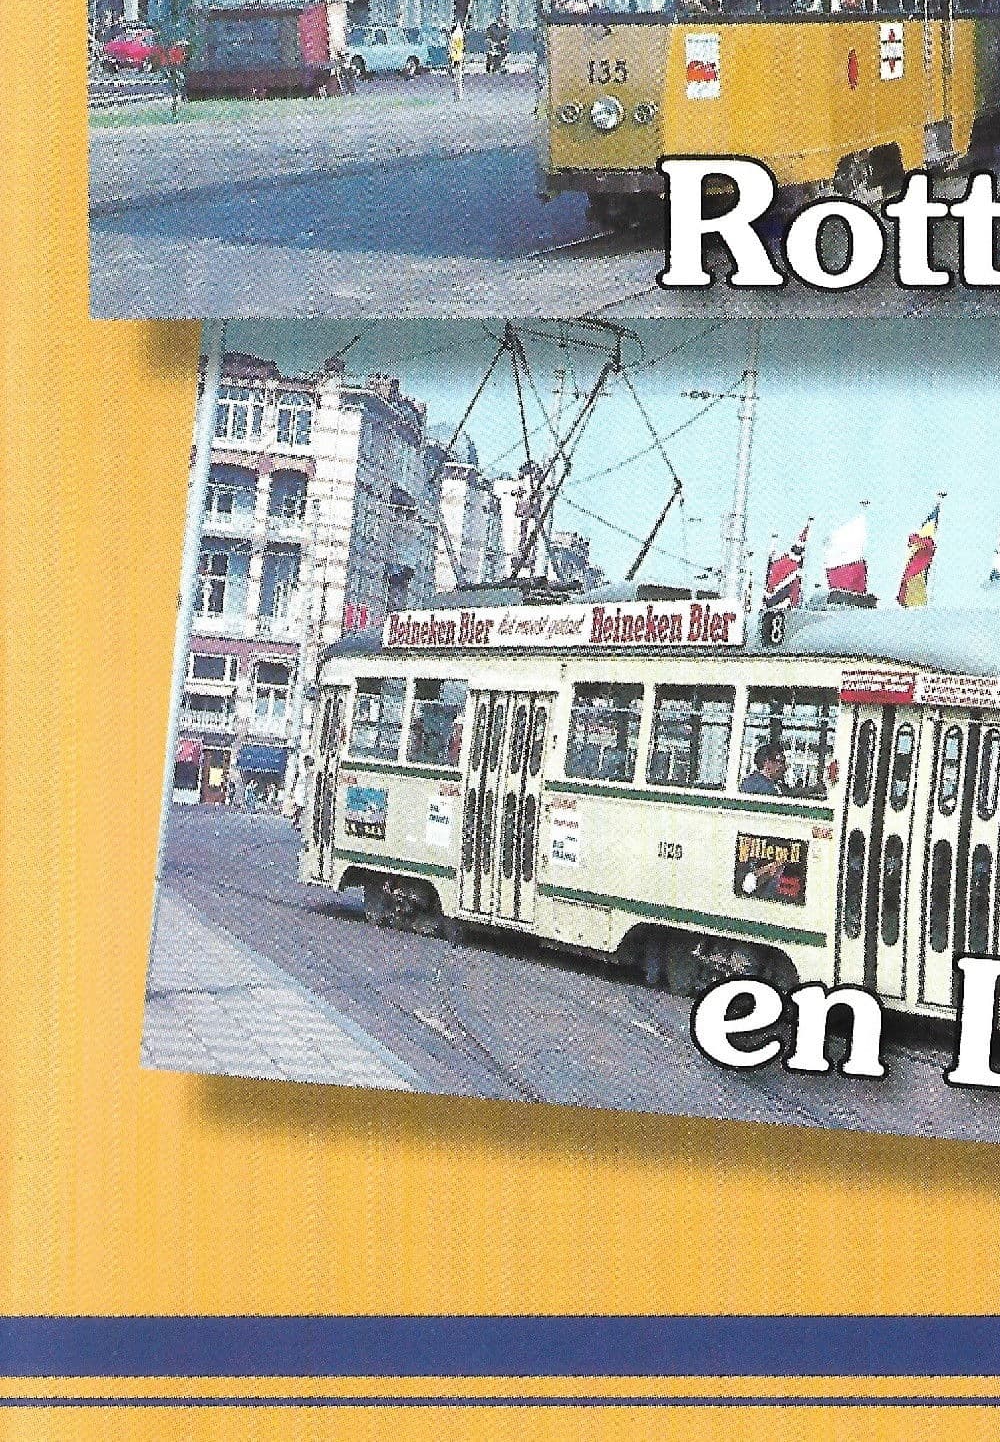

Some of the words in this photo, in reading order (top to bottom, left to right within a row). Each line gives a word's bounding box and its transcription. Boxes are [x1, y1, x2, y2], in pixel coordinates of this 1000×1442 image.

[587, 58, 629, 85] 135
[388, 613, 457, 646] Heineken
[459, 611, 495, 645] Bier
[589, 605, 683, 644] Heineken
[687, 603, 737, 643] Bier
[771, 614, 785, 643] 8
[737, 834, 789, 863] Willem
